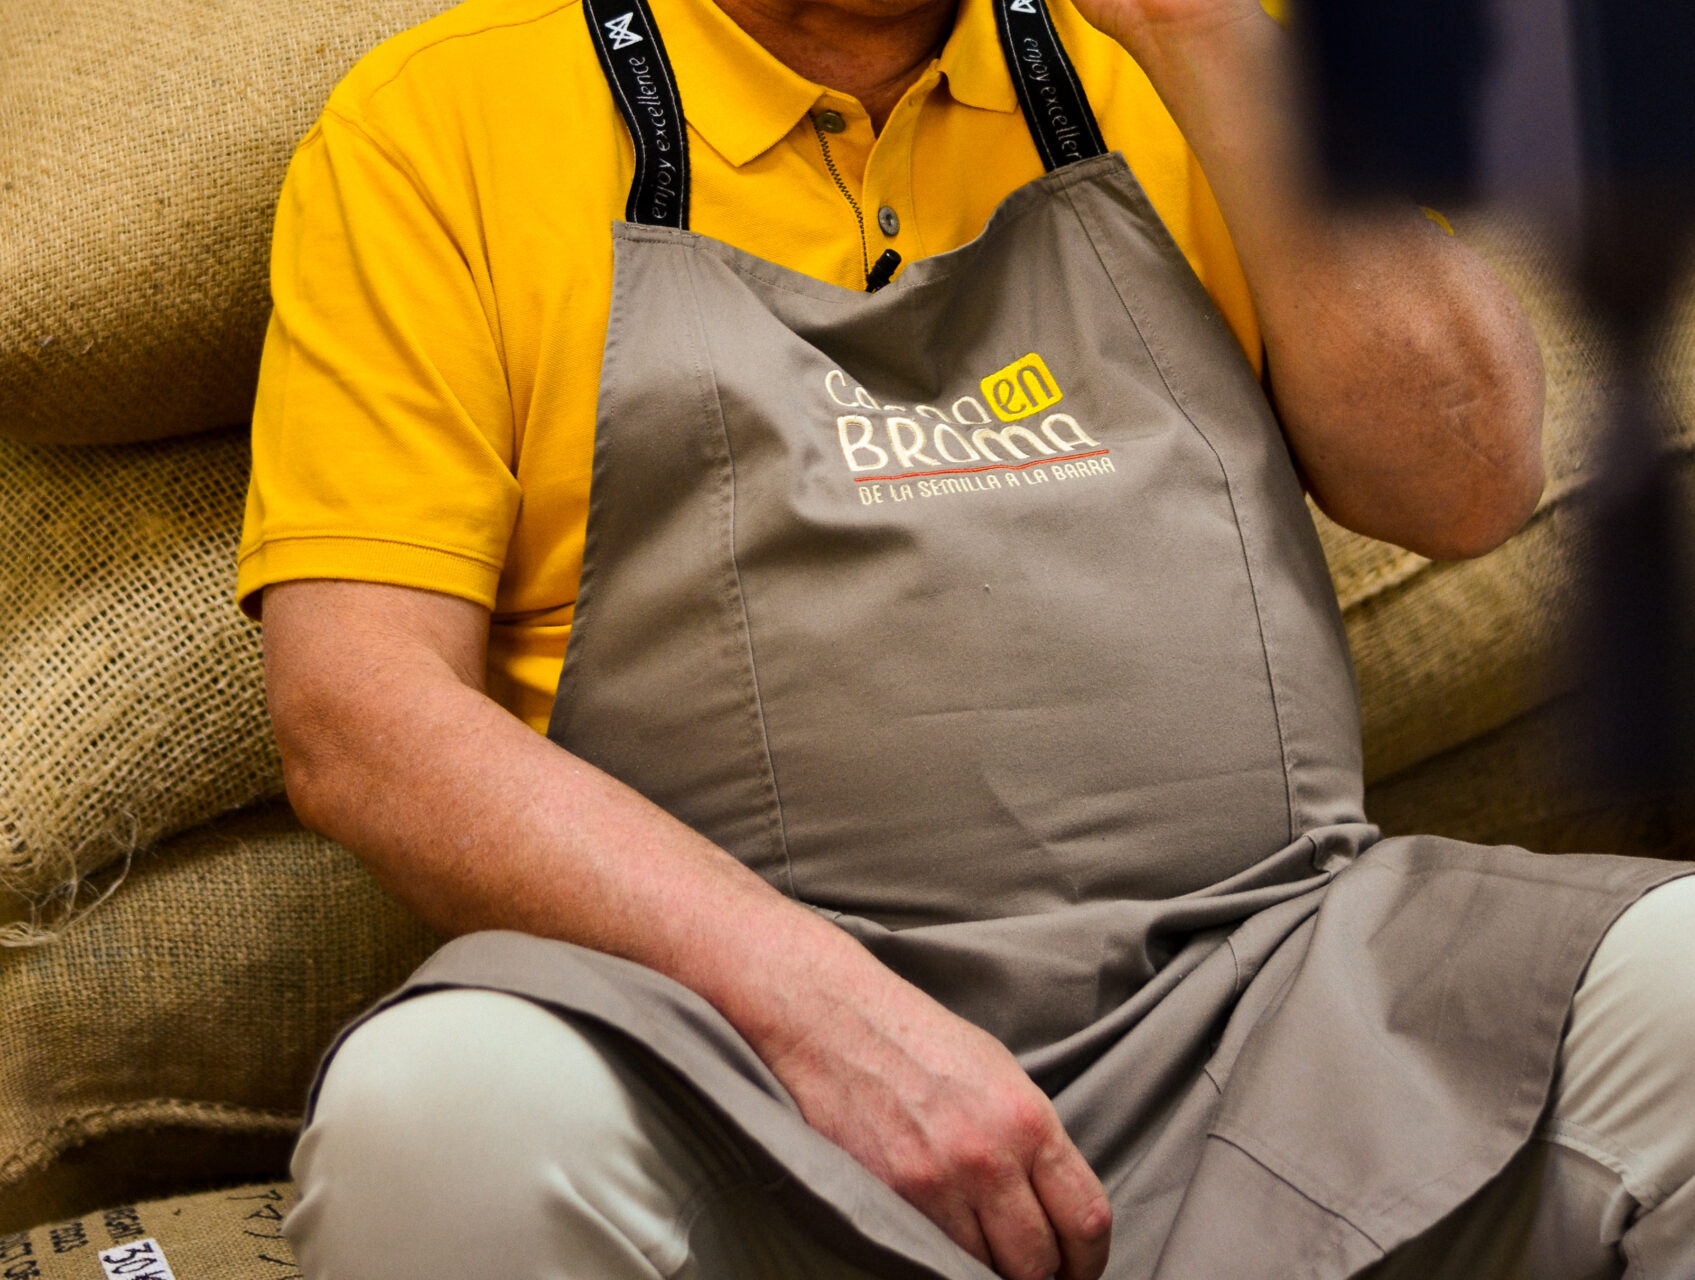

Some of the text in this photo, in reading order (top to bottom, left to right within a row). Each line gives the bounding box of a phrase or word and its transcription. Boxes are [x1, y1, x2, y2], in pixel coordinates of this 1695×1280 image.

[1023, 36, 1050, 83] enjoy
[628, 55, 676, 220] enjoy excellence
[992, 364, 1054, 415] en
[858, 457, 1116, 506] DE LA SEMILLA A LA BARRA
